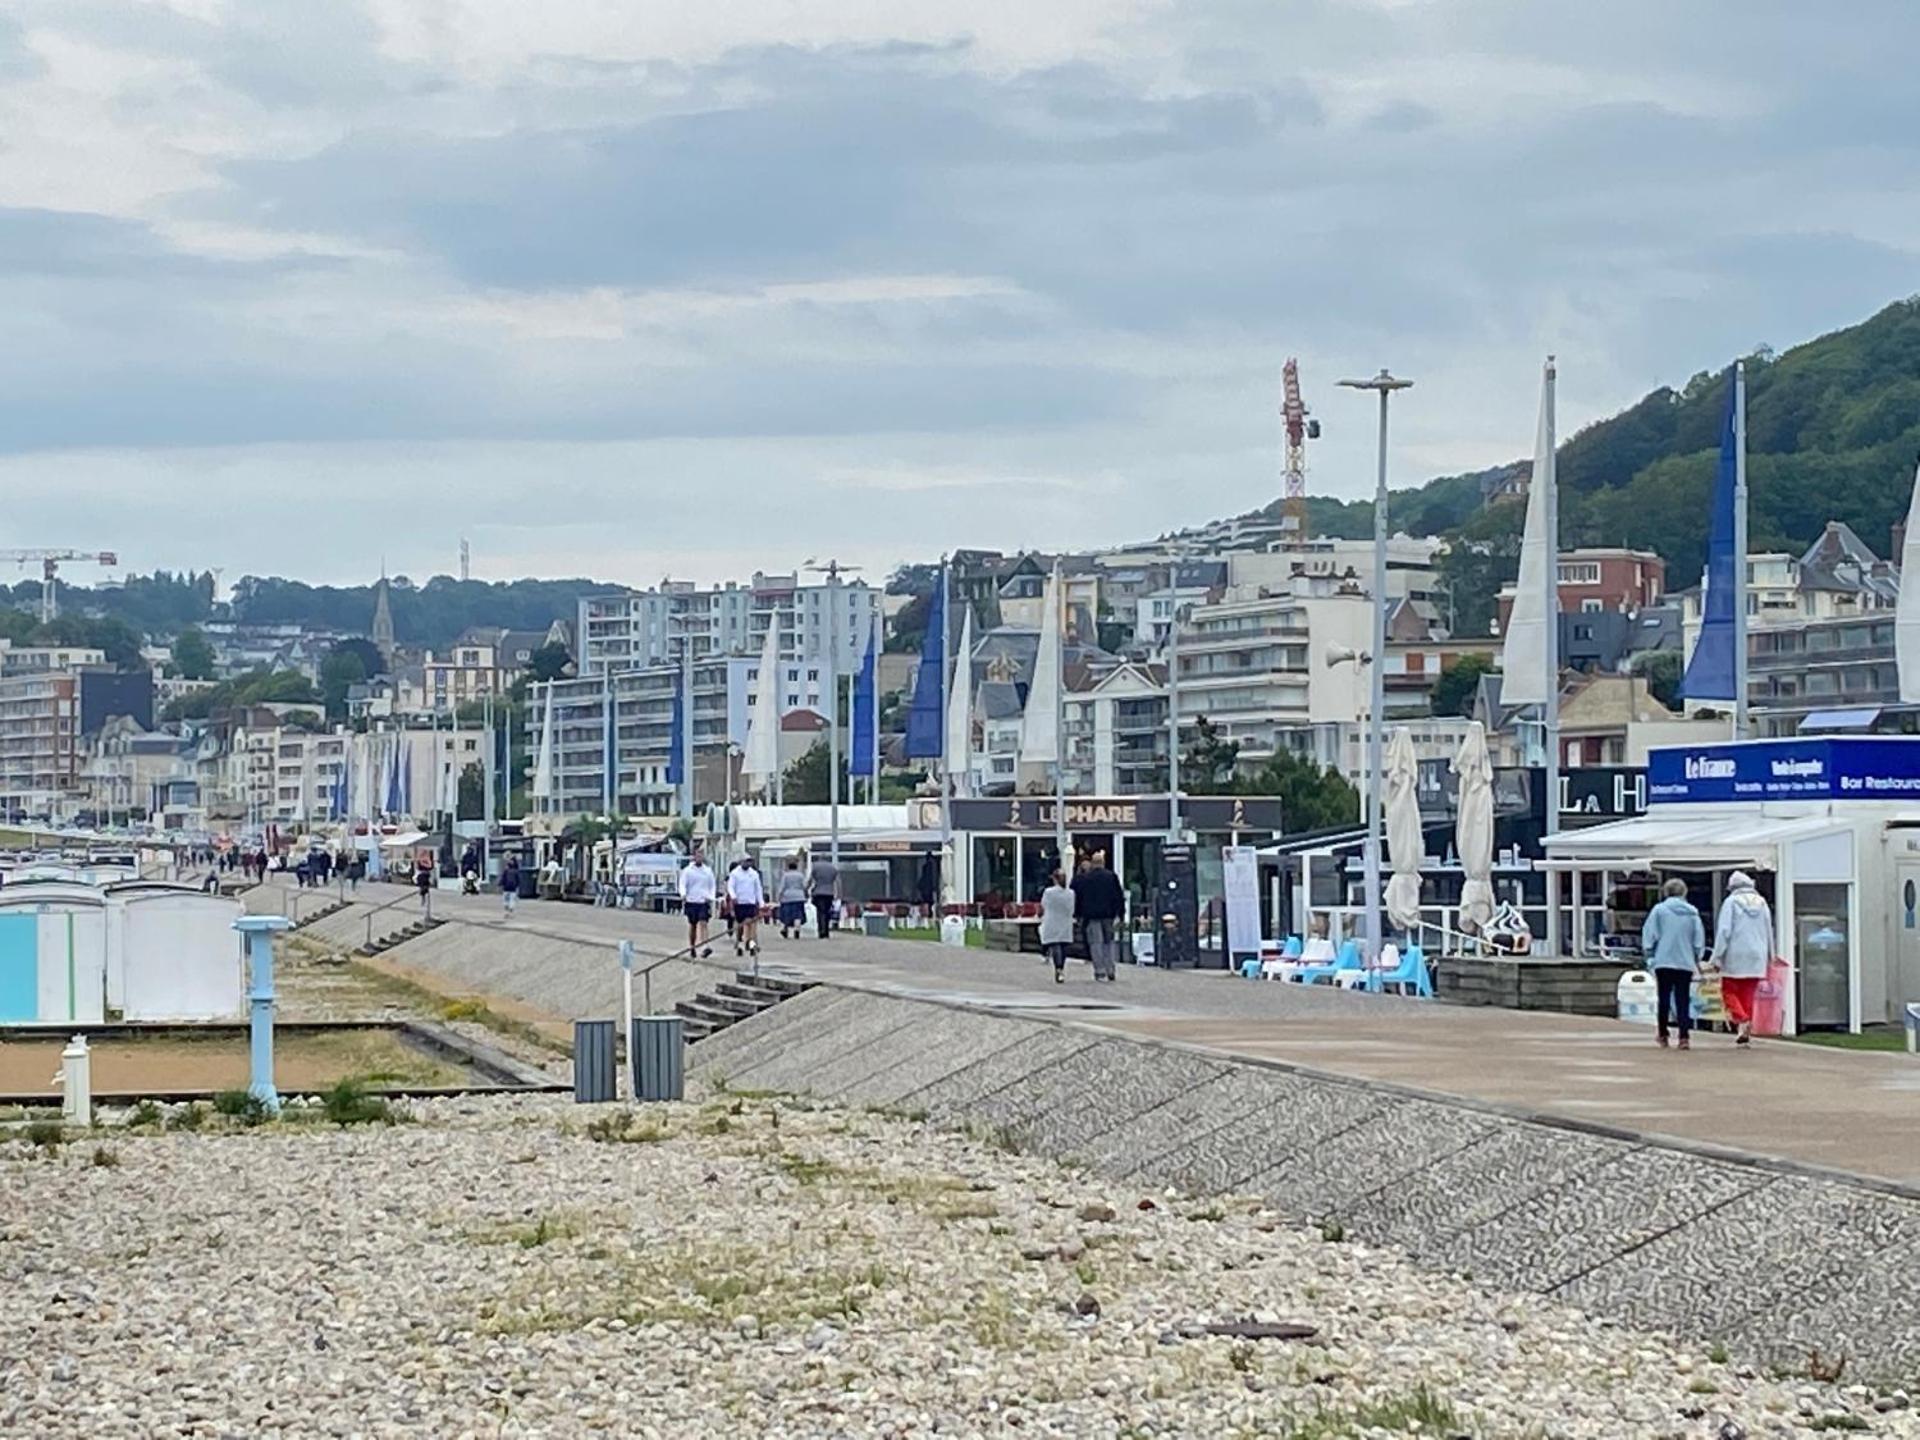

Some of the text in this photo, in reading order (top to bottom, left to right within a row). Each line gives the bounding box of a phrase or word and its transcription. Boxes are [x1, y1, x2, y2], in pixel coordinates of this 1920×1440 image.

[1685, 757, 1699, 779] Le
[1841, 776, 1862, 789] Bar
[1064, 805, 1136, 823] PHARE
